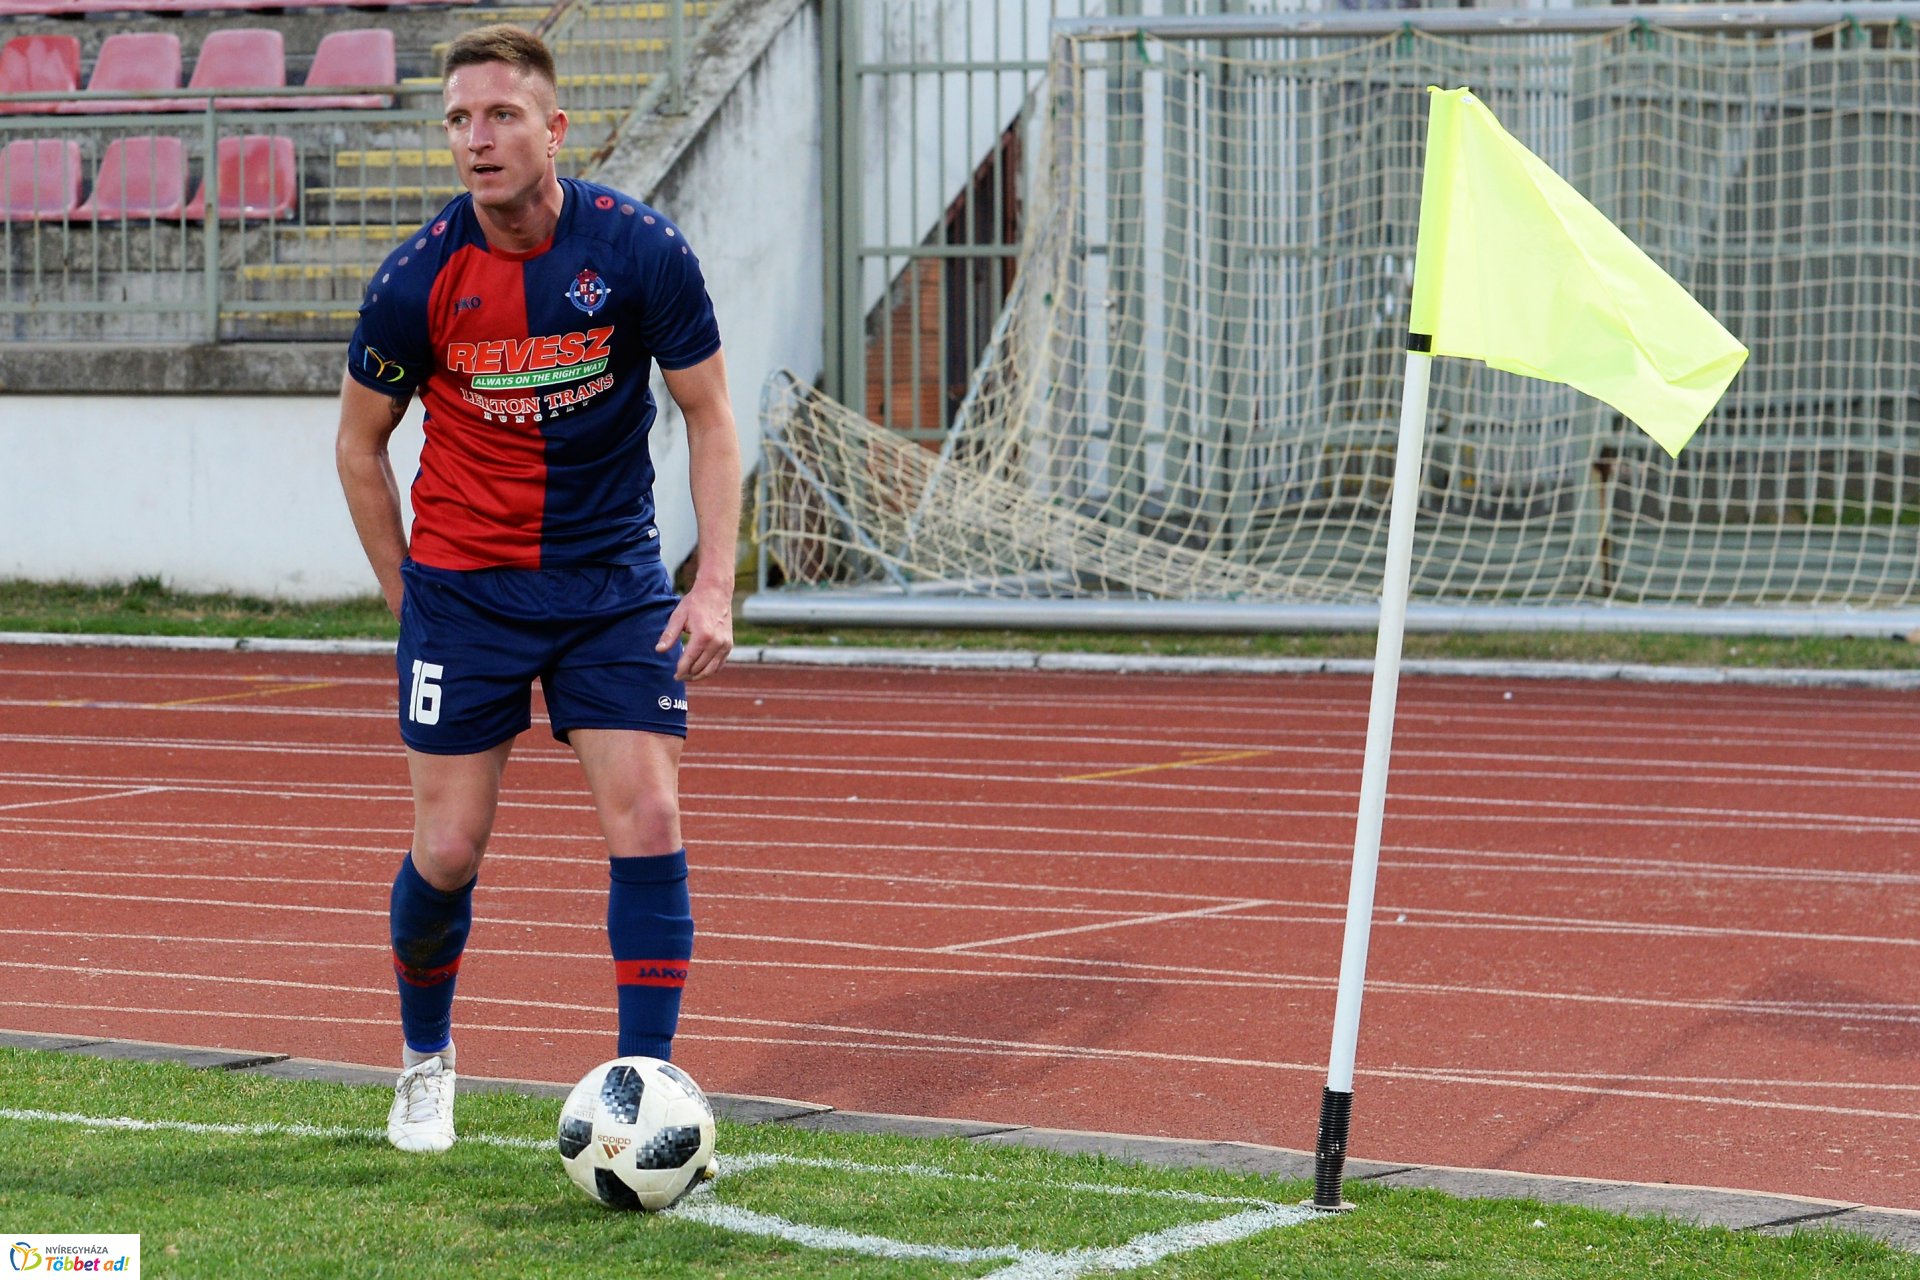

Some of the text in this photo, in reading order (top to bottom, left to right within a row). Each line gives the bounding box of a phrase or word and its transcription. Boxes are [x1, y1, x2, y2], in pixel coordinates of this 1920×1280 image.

[447, 325, 615, 373] REVESZ
[475, 361, 604, 386] ALWAYS ON THE RIGHT WAY
[544, 373, 614, 410] TRANS
[409, 659, 444, 726] 16
[637, 967, 688, 979] JAKO
[597, 1134, 632, 1145] adidas
